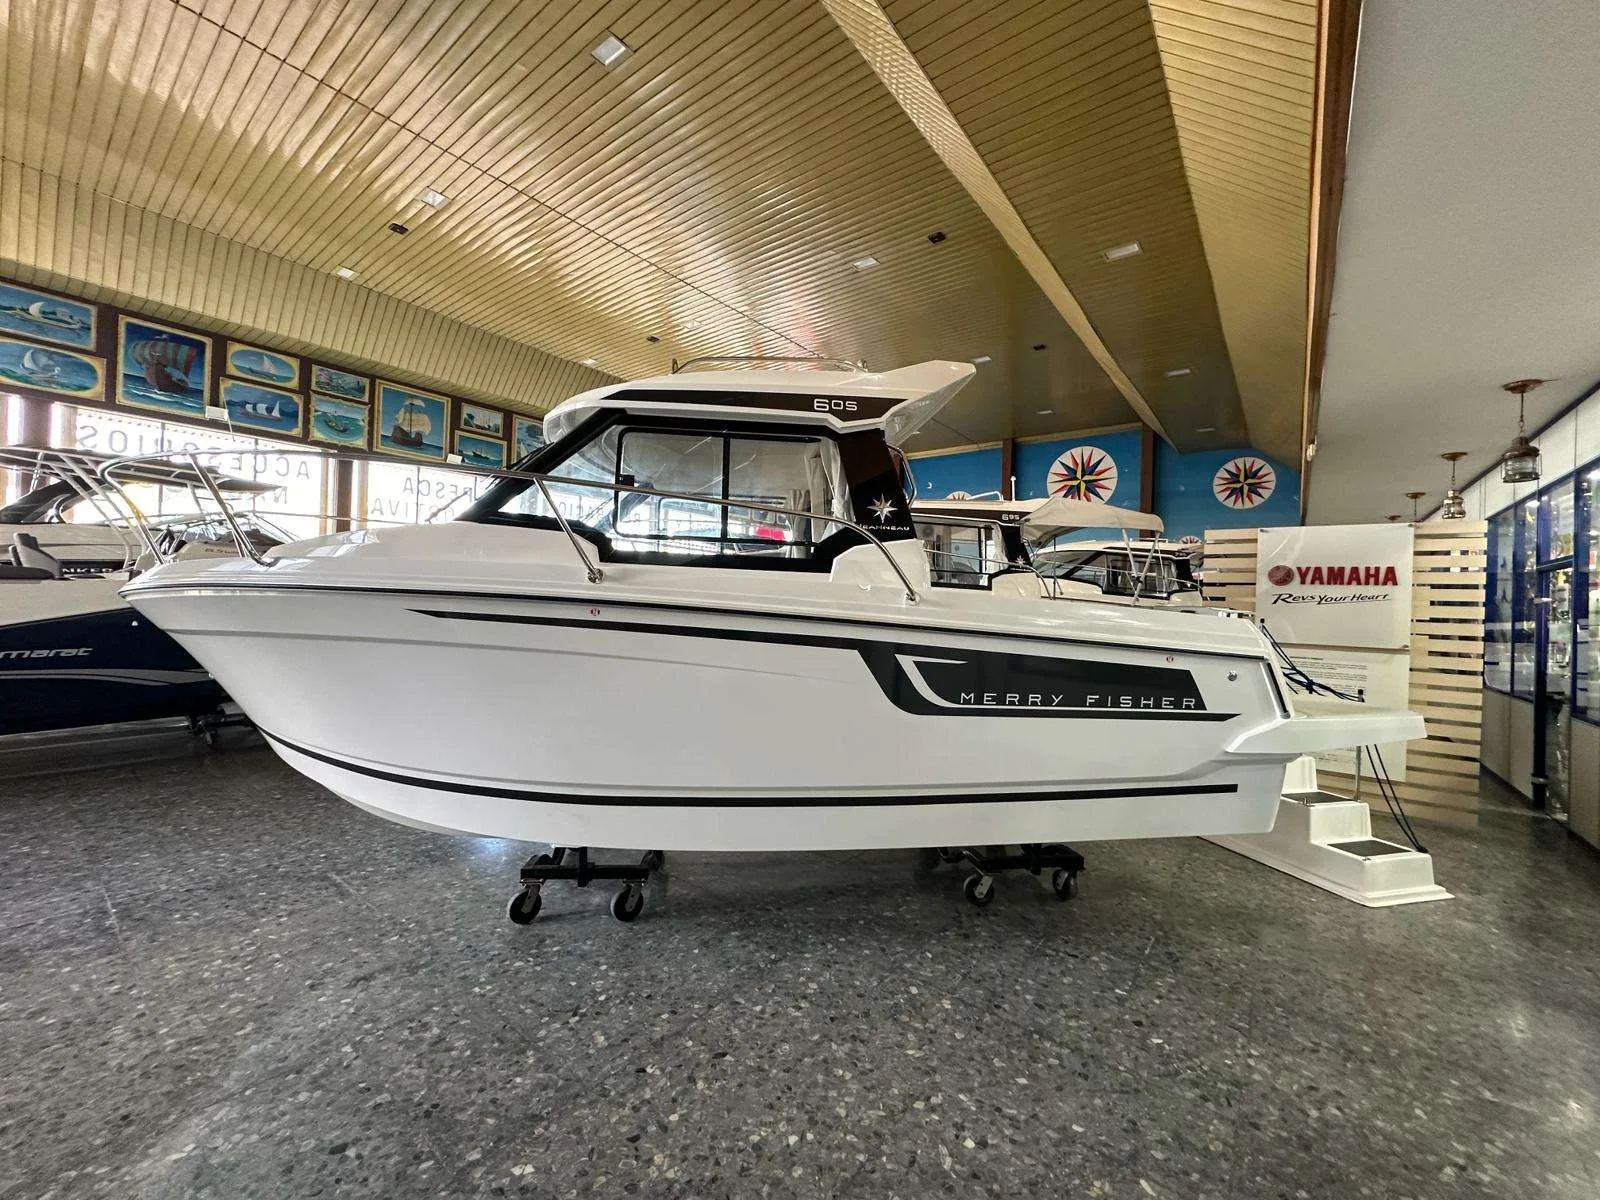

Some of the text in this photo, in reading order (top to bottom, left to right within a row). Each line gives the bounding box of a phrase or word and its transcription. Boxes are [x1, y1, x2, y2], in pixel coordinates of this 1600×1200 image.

[813, 398, 858, 412] 605
[1296, 566, 1398, 586] YAMAHA
[1272, 592, 1390, 605] Revs Your Heart
[960, 692, 1196, 709] MERRY FISHER
